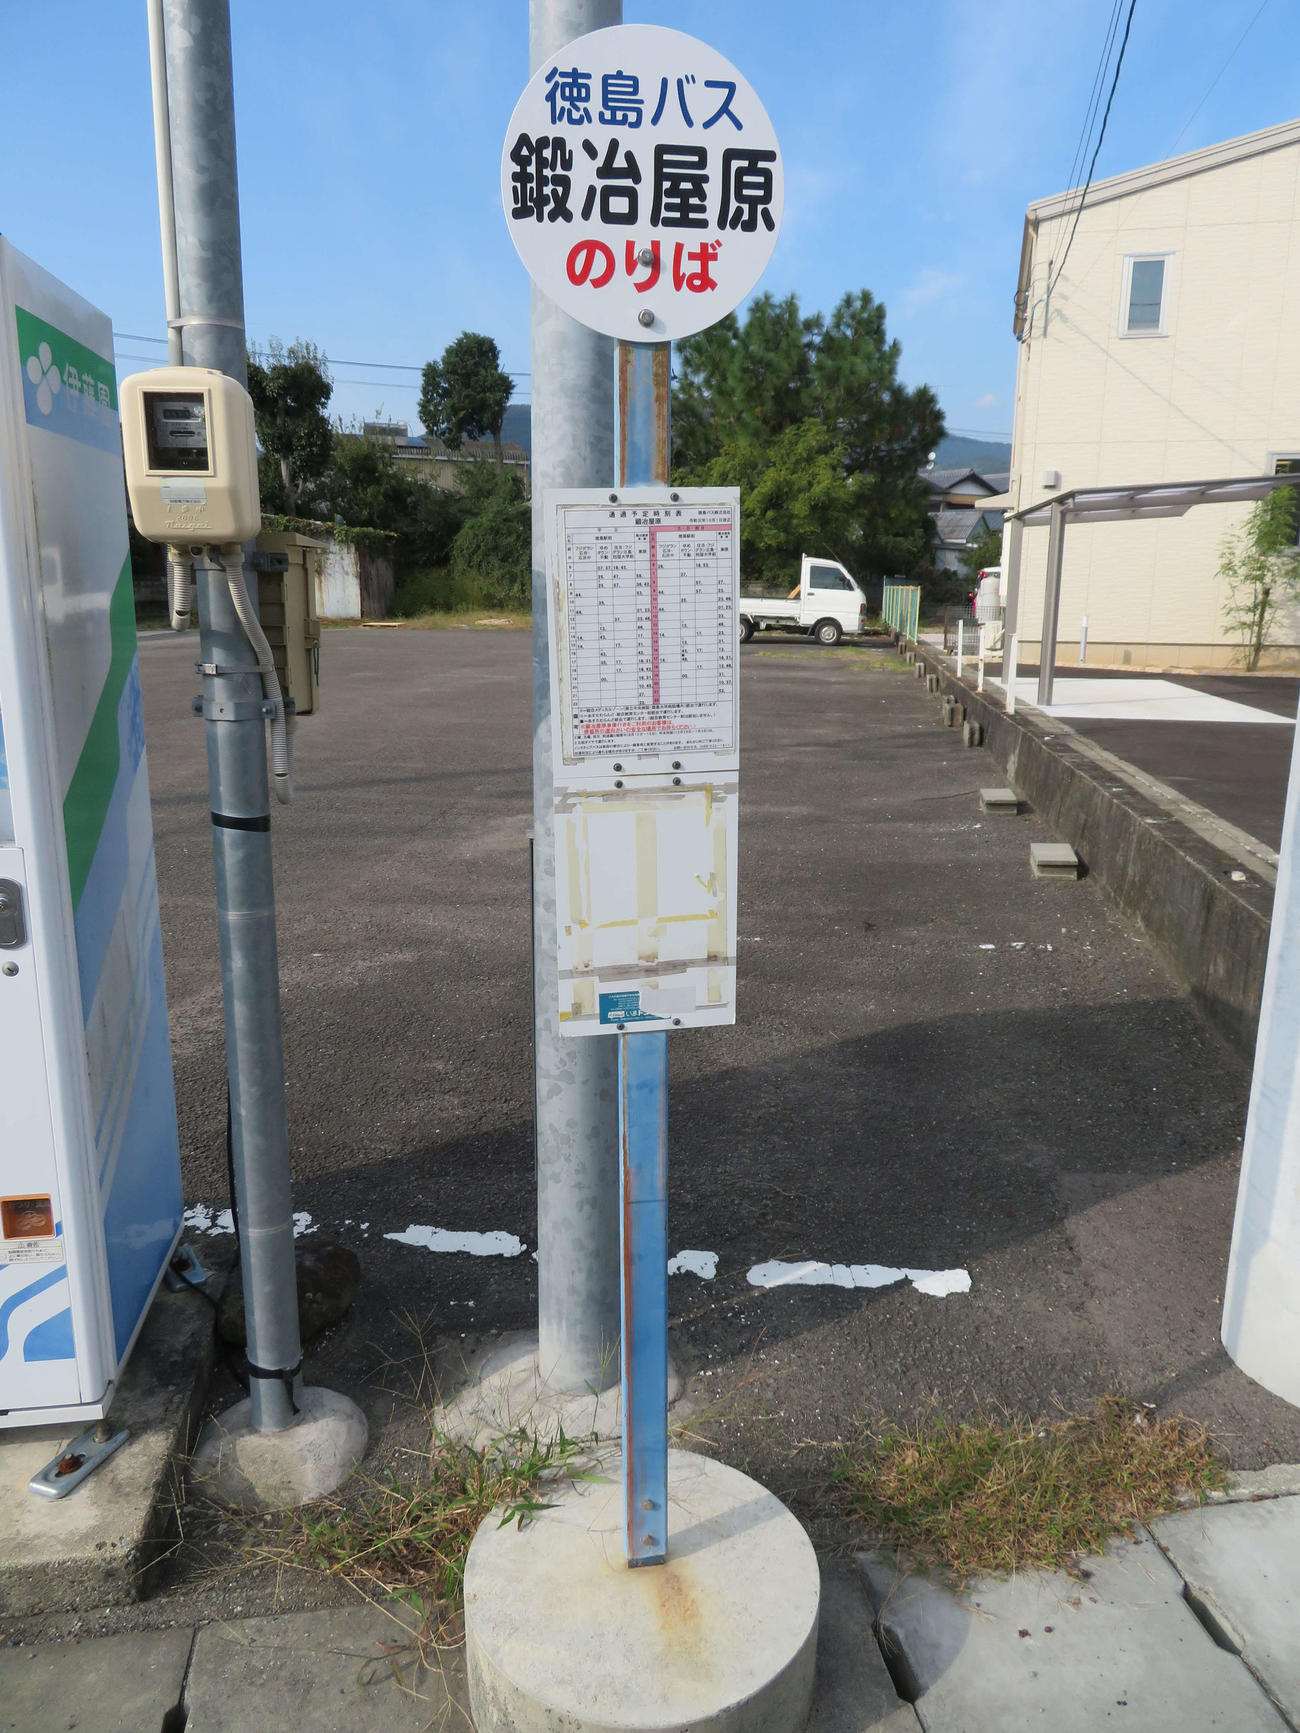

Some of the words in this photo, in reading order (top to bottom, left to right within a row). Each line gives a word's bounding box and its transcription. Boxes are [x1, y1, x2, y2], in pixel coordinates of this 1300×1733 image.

[545, 66, 743, 131] 徳島バス
[510, 132, 777, 232] 鍛冶屋原
[566, 238, 723, 293] のりば
